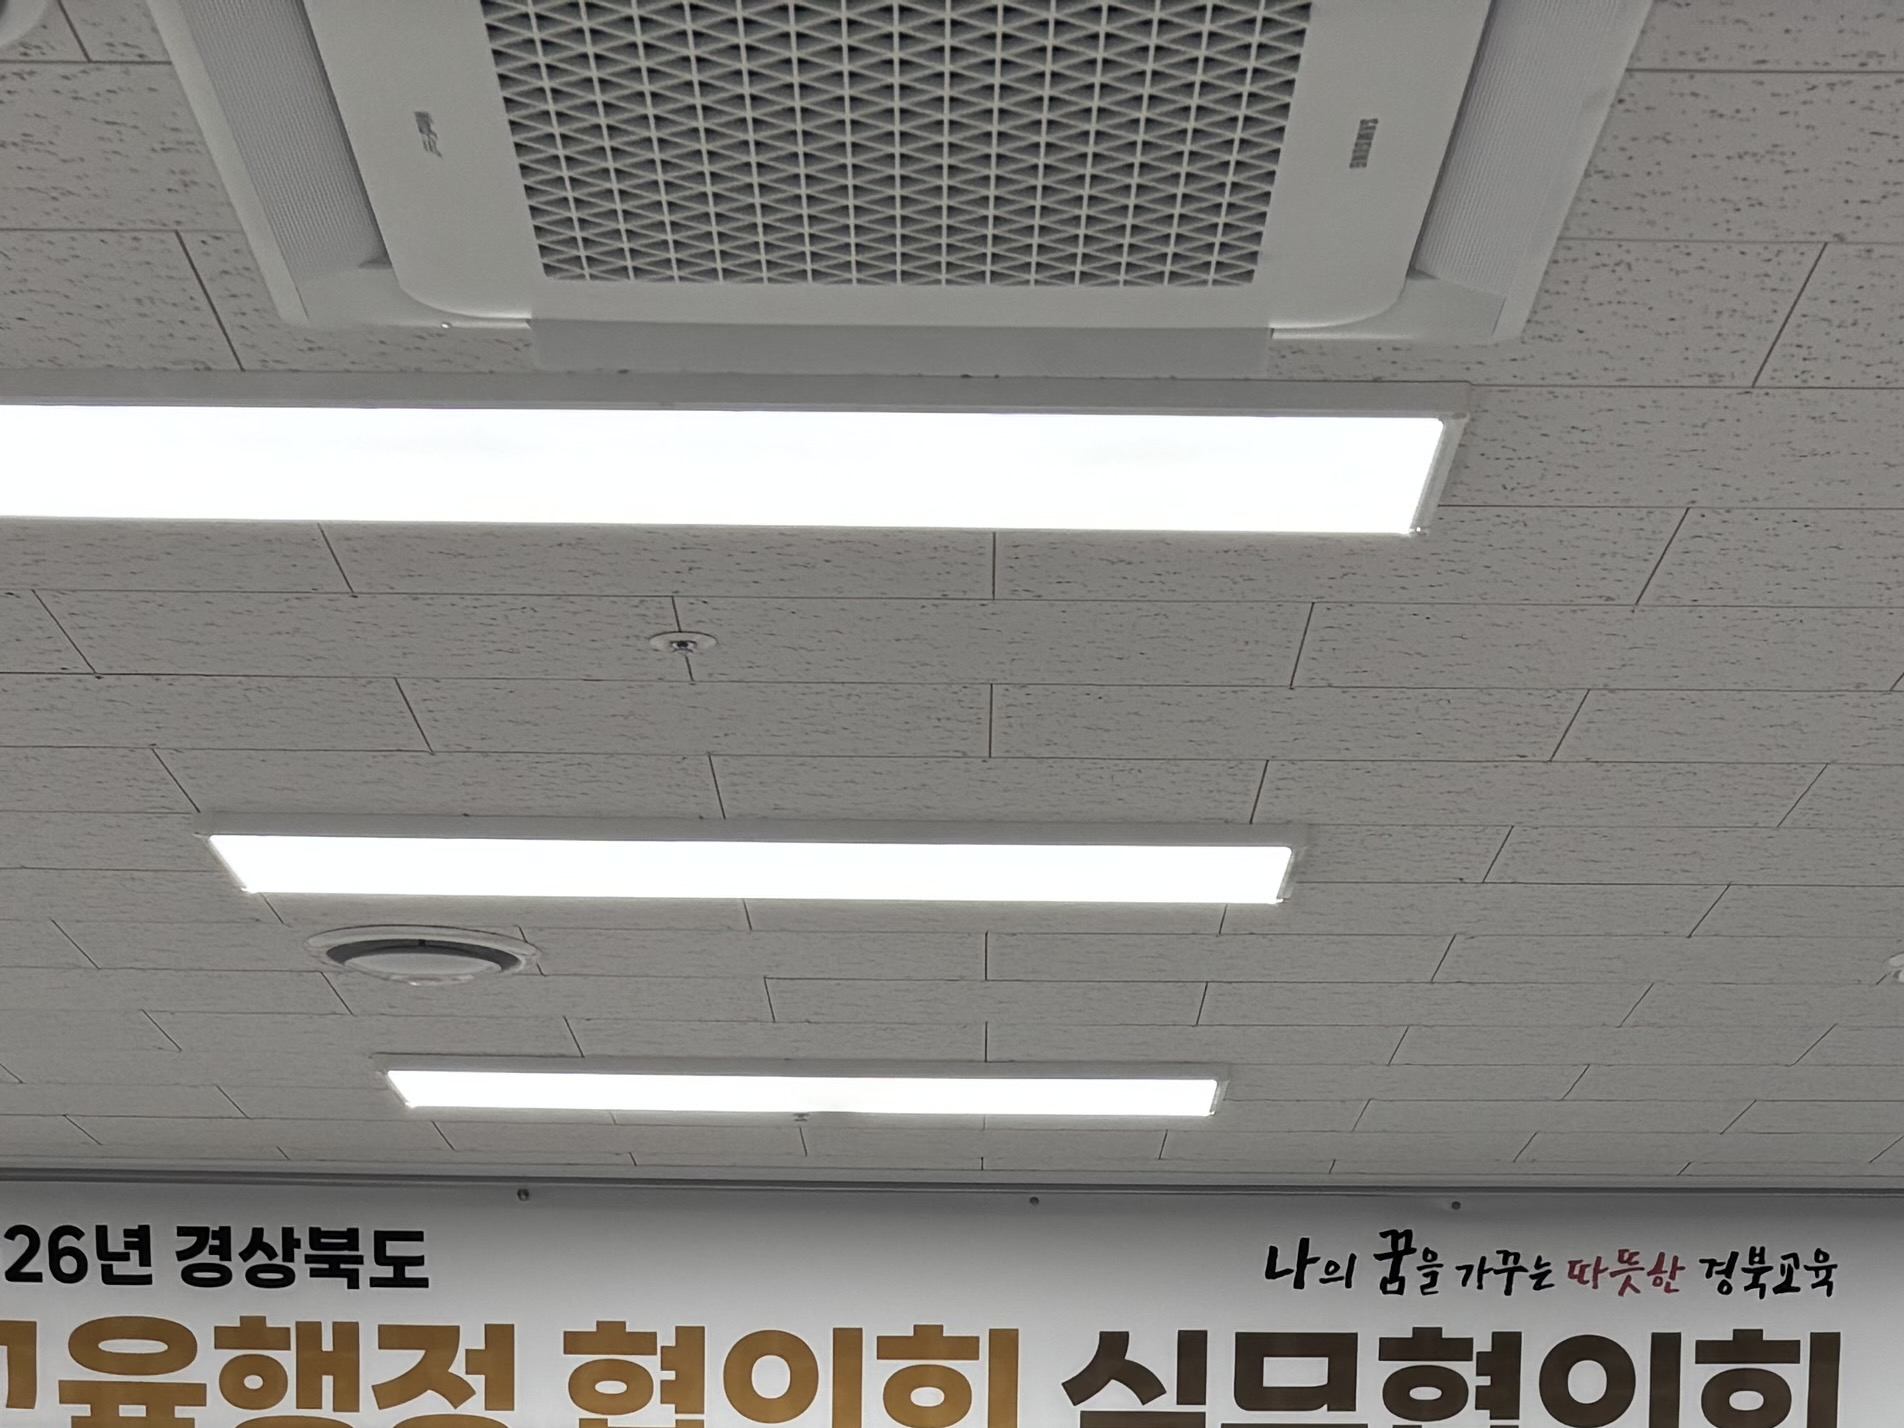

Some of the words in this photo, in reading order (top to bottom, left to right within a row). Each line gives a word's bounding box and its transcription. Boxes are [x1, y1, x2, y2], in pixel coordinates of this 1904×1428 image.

[176, 1226, 431, 1291] 경상북도
[1264, 1238, 1356, 1290] 나의
[1373, 1229, 1444, 1295] 꿈을
[1456, 1249, 1555, 1296] 가꾸는
[1568, 1248, 1686, 1297] 따뜻한
[1699, 1246, 1838, 1300] 경북교육
